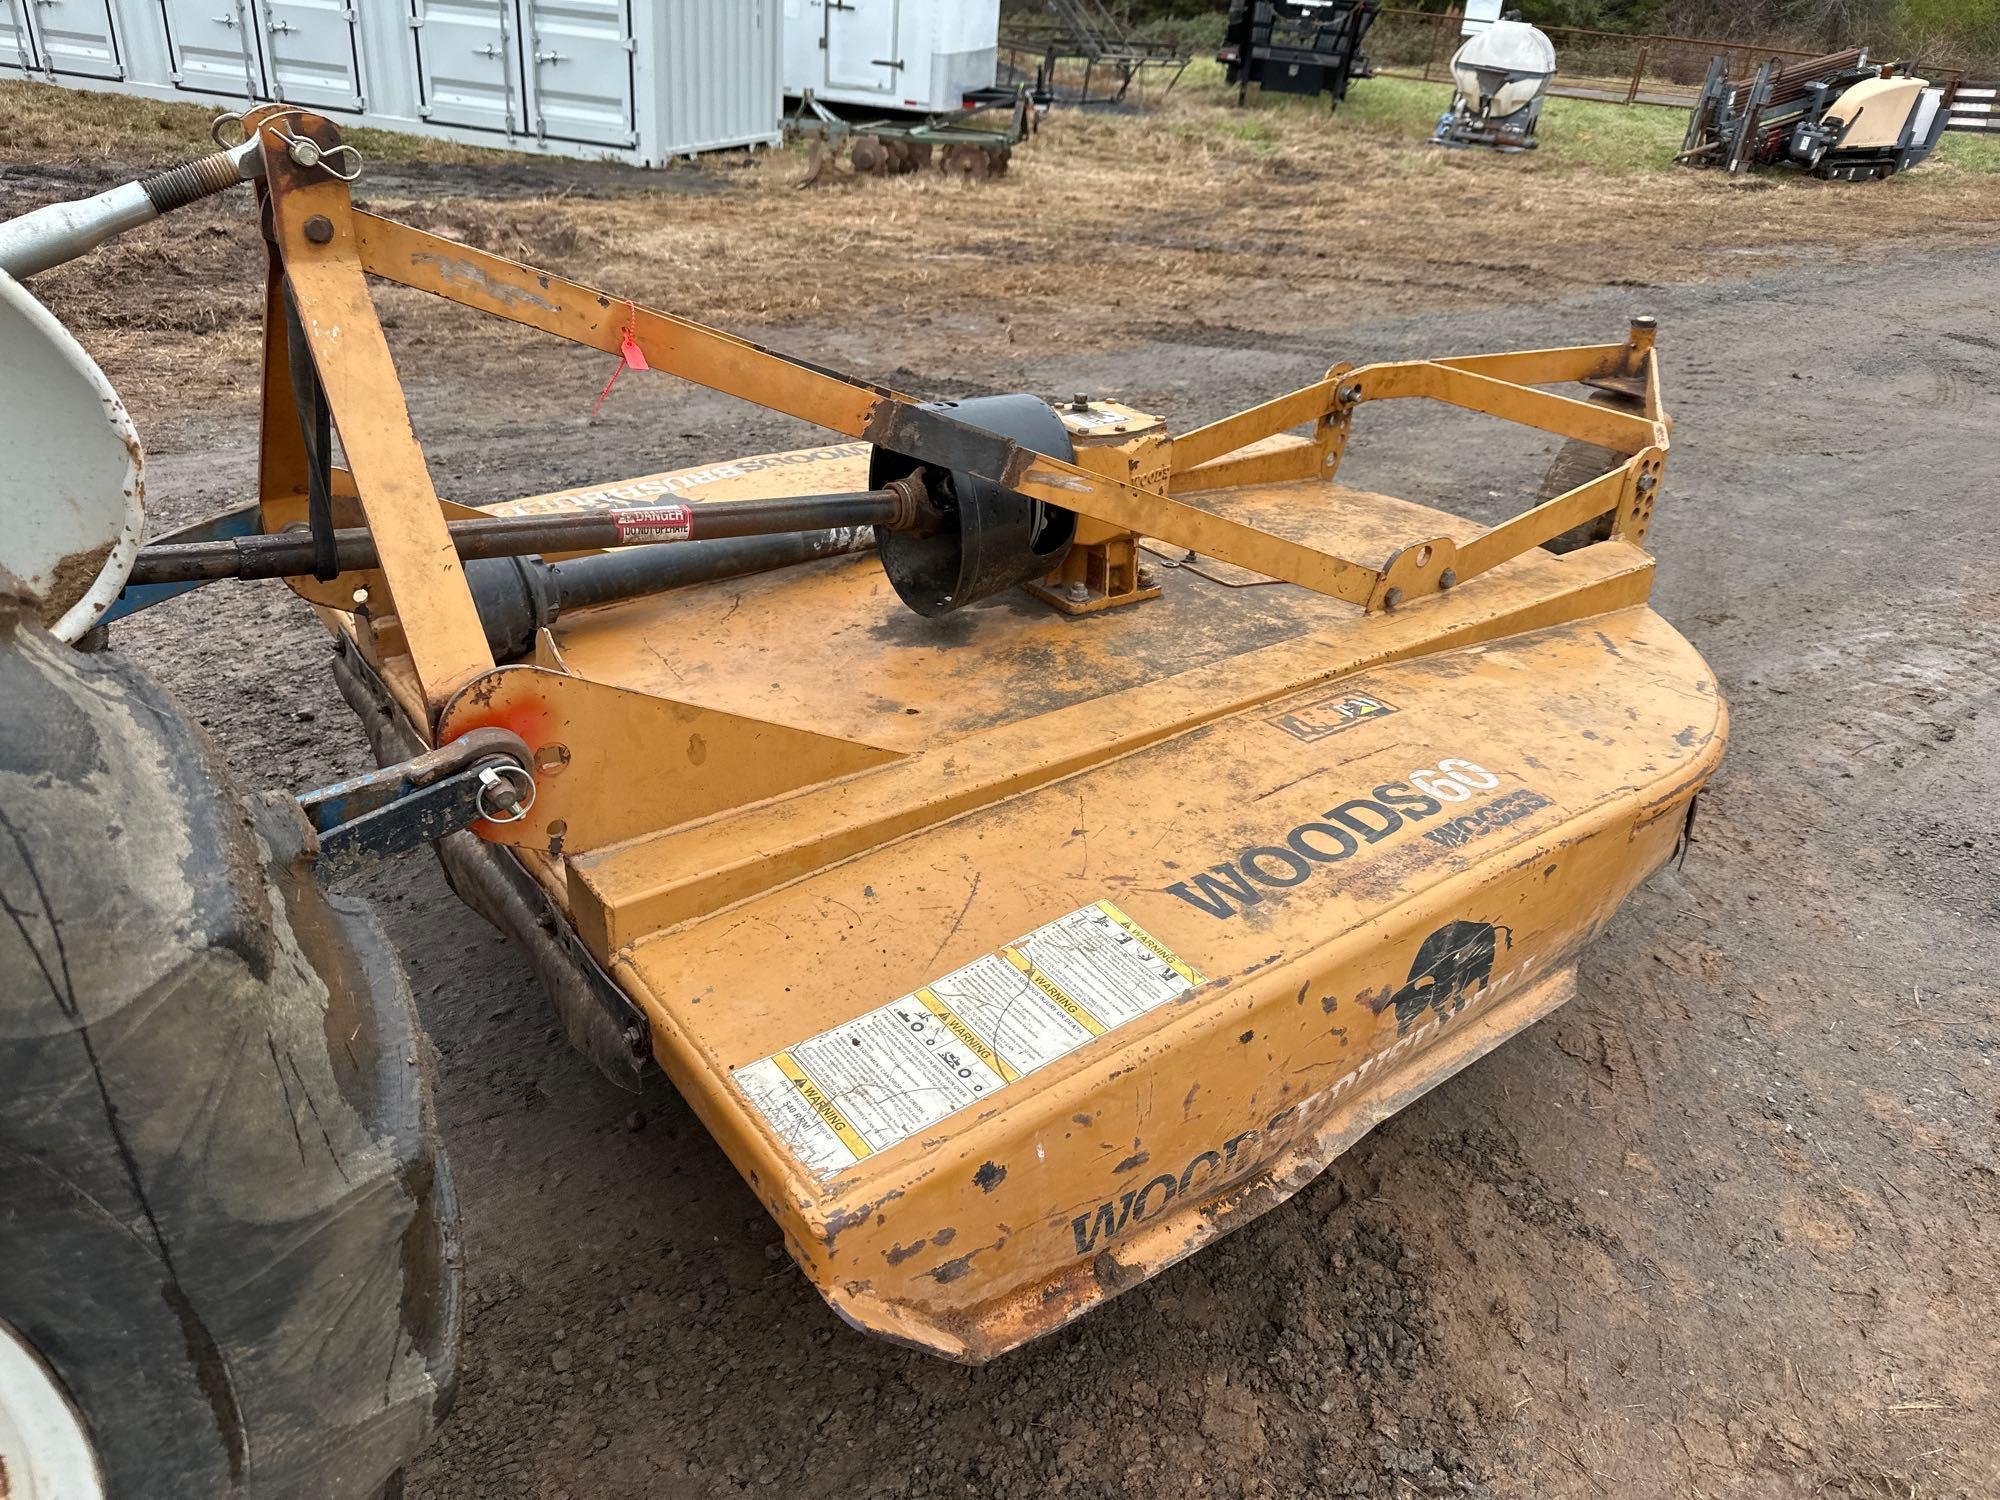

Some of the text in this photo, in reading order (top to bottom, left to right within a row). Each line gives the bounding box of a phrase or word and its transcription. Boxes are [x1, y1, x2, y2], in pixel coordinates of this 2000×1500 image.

[636, 509, 684, 521] DANGER
[1130, 928, 1176, 963] WARNING
[1002, 964, 1019, 977] AVOID
[1016, 976, 1040, 996] SERIOUS
[1037, 995, 1058, 1011] INJURY
[1055, 1010, 1067, 1019] OR
[1063, 1017, 1084, 1034] DEATH
[1032, 975, 1079, 1013] WARNING
[947, 1020, 992, 1058] WARNING
[781, 1100, 797, 1113] 540
[802, 1087, 847, 1131] WARNING
